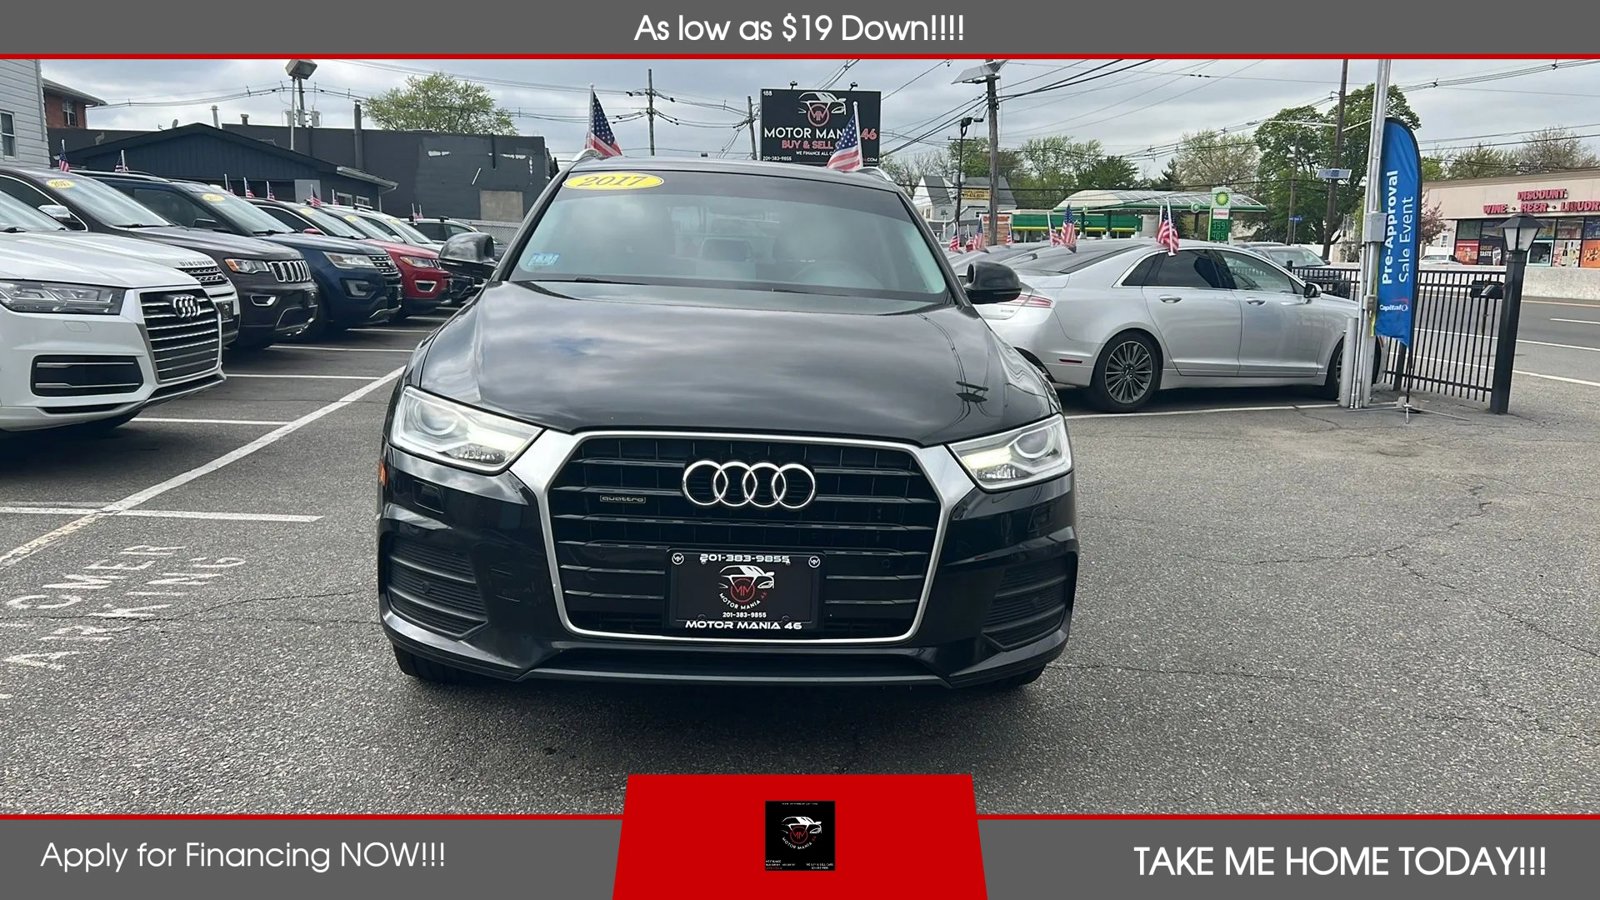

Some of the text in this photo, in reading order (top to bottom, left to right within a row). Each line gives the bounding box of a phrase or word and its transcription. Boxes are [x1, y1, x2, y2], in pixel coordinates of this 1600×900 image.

[764, 127, 877, 140] MOTOR MAN 46
[781, 140, 801, 149] BUY
[803, 140, 810, 149] &
[812, 140, 833, 149] SELL
[577, 175, 649, 187] 2017
[1518, 189, 1567, 200] DISCOUNT
[1483, 203, 1508, 215] WINE
[1561, 201, 1600, 213] LIQUOR
[1382, 170, 1399, 285] Pre-Approval
[1398, 196, 1413, 283] Sale Event
[700, 553, 790, 564] 201-383-9855
[719, 592, 740, 610] MOTOR
[740, 600, 761, 610] MANIA
[685, 620, 802, 630] MOTOR MANIA 46
